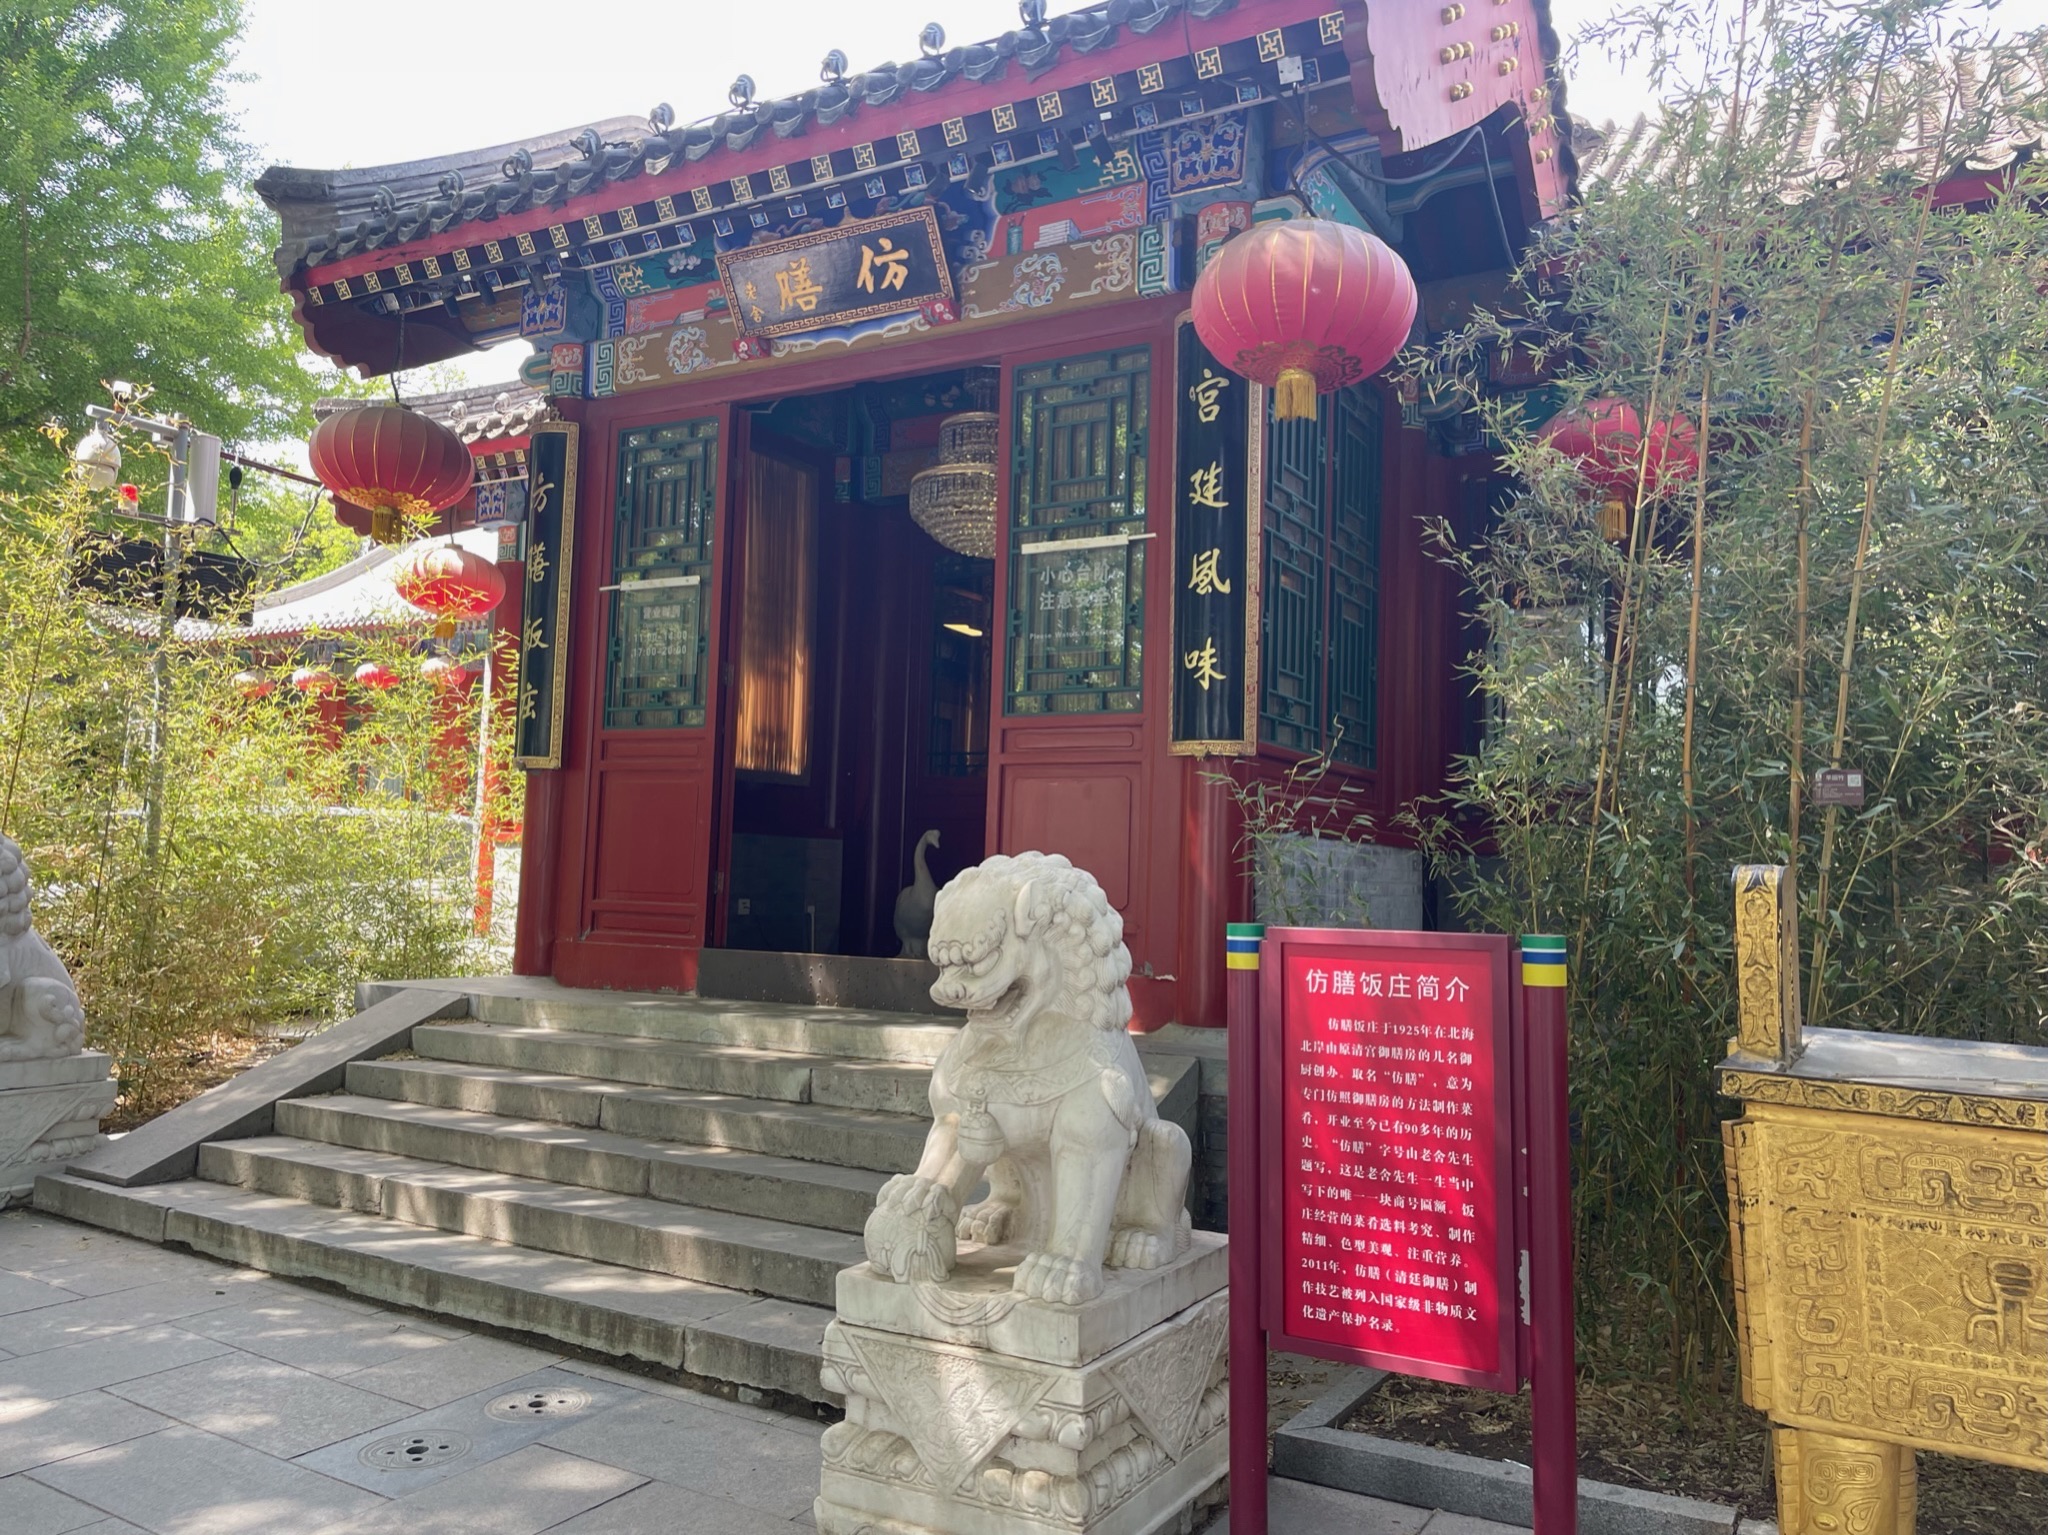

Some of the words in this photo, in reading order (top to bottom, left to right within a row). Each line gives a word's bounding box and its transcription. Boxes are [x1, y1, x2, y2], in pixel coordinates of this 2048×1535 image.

[775, 237, 910, 315] 仿膳
[1040, 559, 1110, 585] 小心台阶
[1040, 586, 1110, 610] 注意安全
[1305, 968, 1470, 1003] 仿膳饭庄简介
[1327, 1017, 1475, 1041] 仿膳饭庄于1925年在北海
[1302, 1087, 1473, 1116] 专门仿照御膳房的方法制作菜
[1302, 1281, 1477, 1321] 作技艺被列入国家级非物质文
[1302, 1305, 1400, 1333] 化遗产保护名录。
